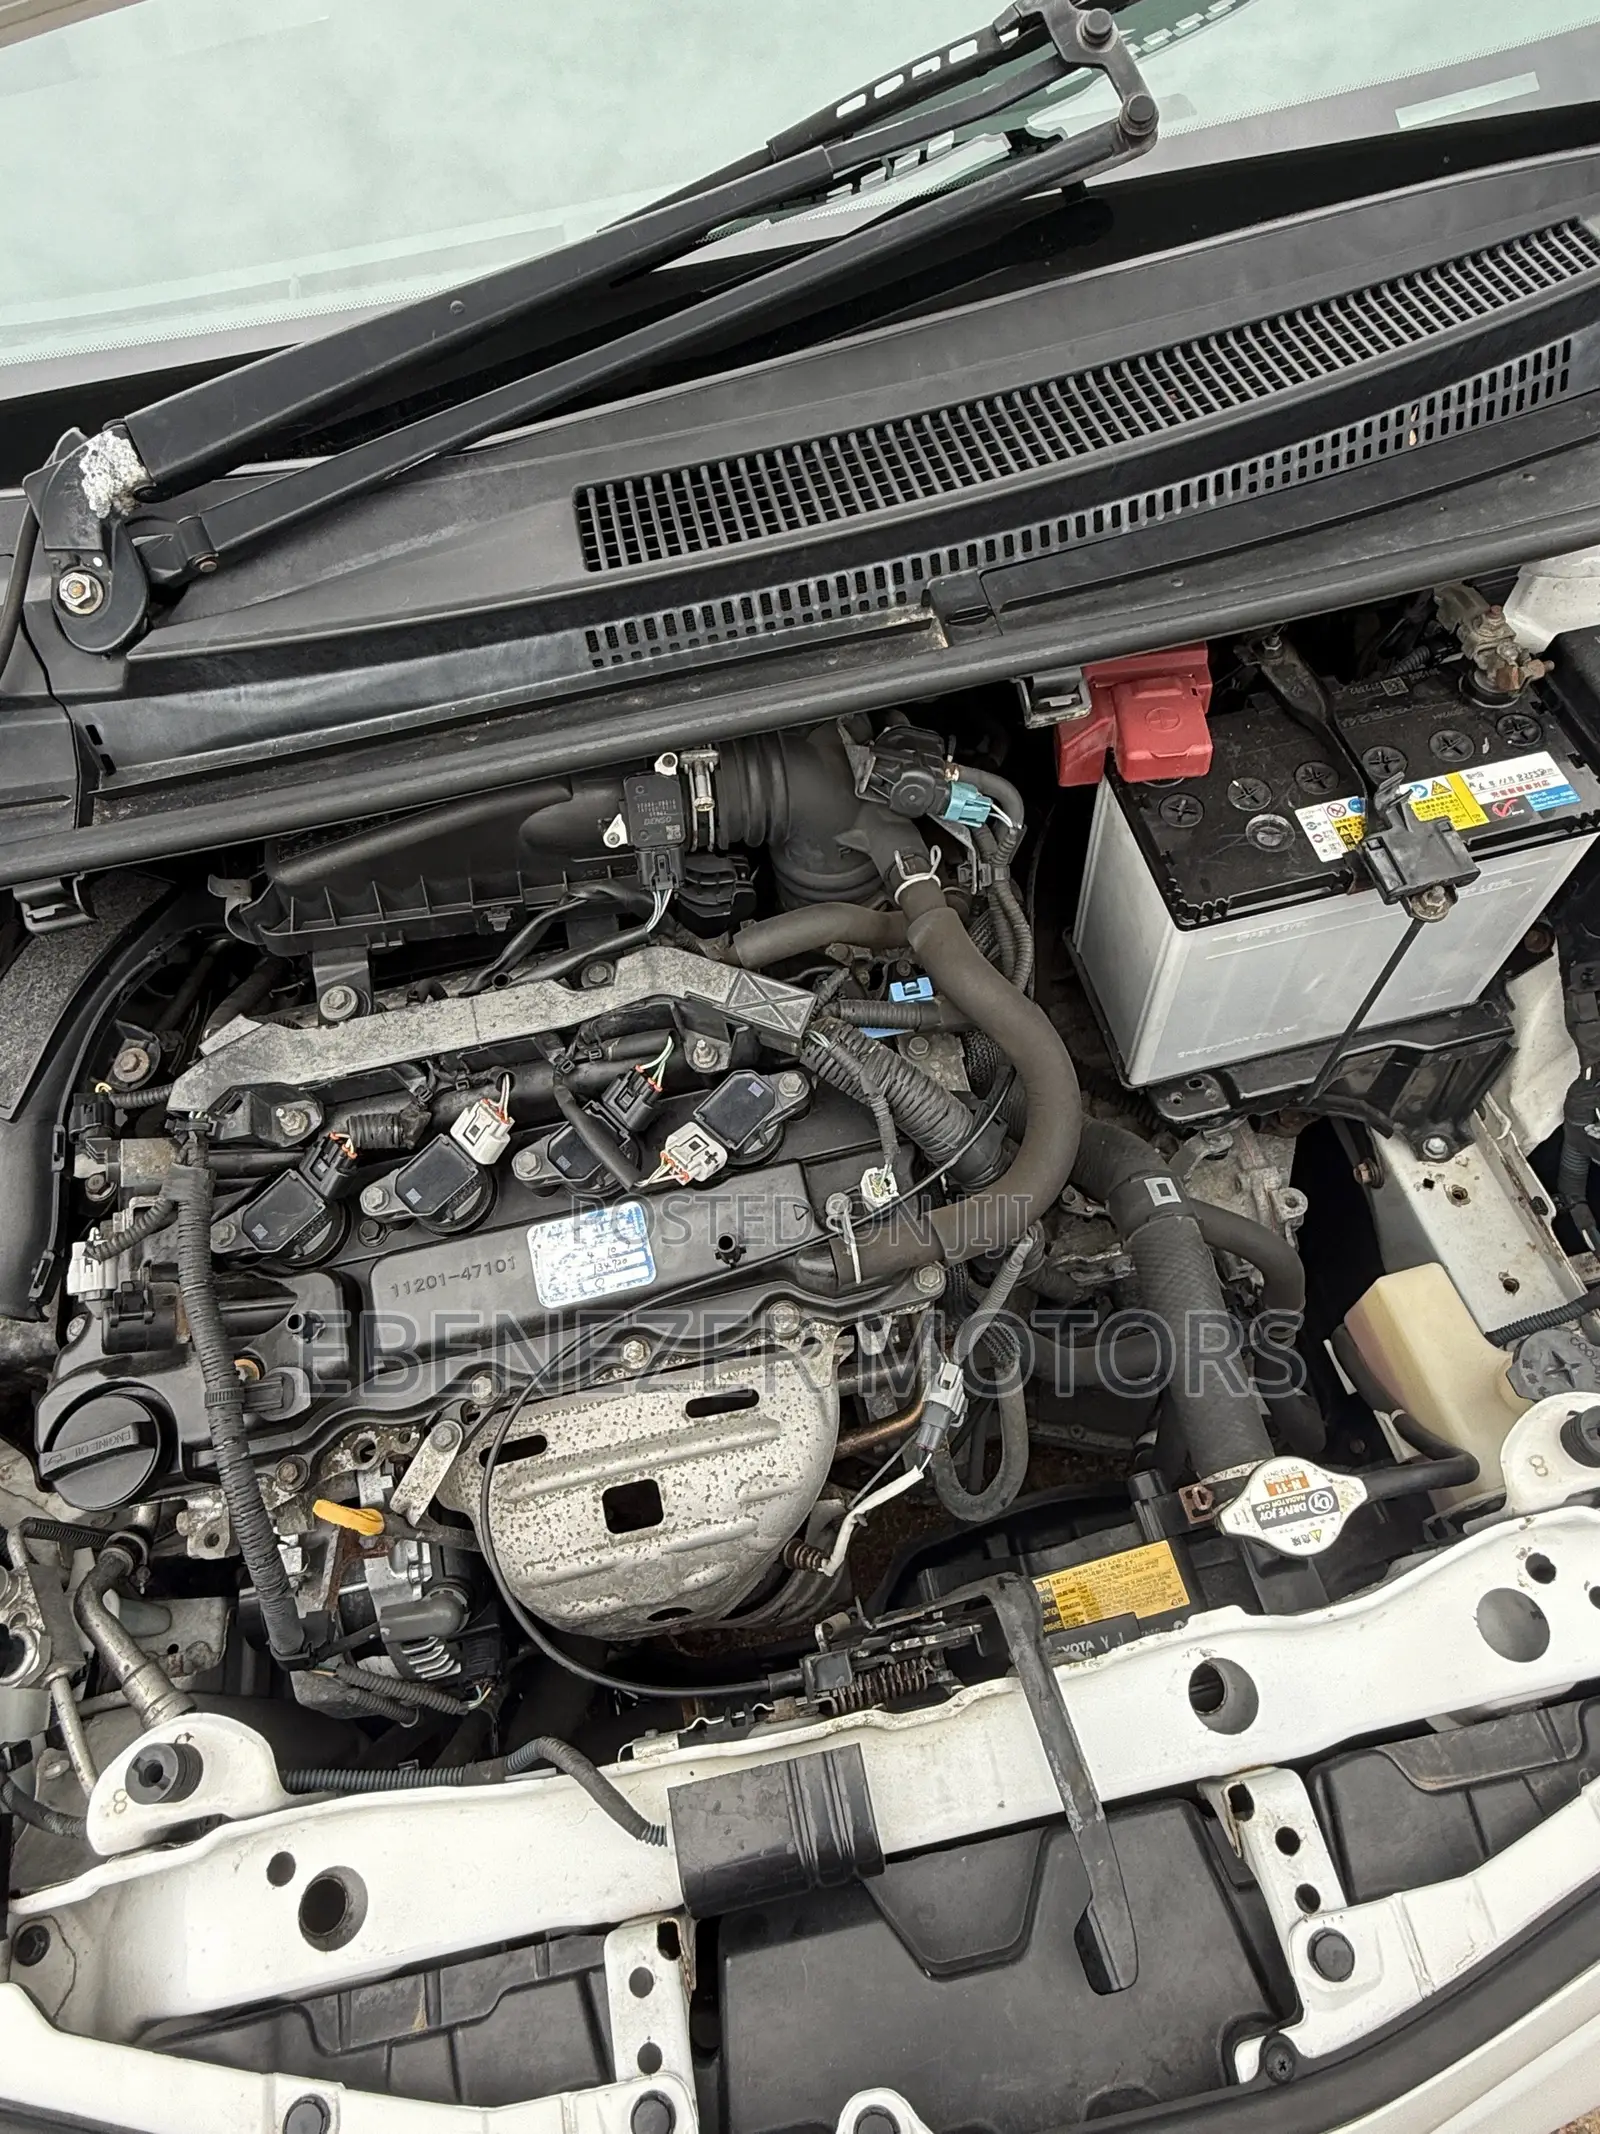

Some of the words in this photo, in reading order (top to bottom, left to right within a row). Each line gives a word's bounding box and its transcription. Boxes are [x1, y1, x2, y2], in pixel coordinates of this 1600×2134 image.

[390, 1256, 516, 1297] 11201-47101
[91, 1430, 132, 1450] ENGINE
[74, 1447, 89, 1457] OIL
[1275, 1478, 1303, 1495] N-11
[1255, 1503, 1271, 1512] CAP
[1271, 1494, 1306, 1508] RADIATOR
[1259, 1508, 1278, 1522] JOY
[1278, 1502, 1308, 1517] DRIVE
